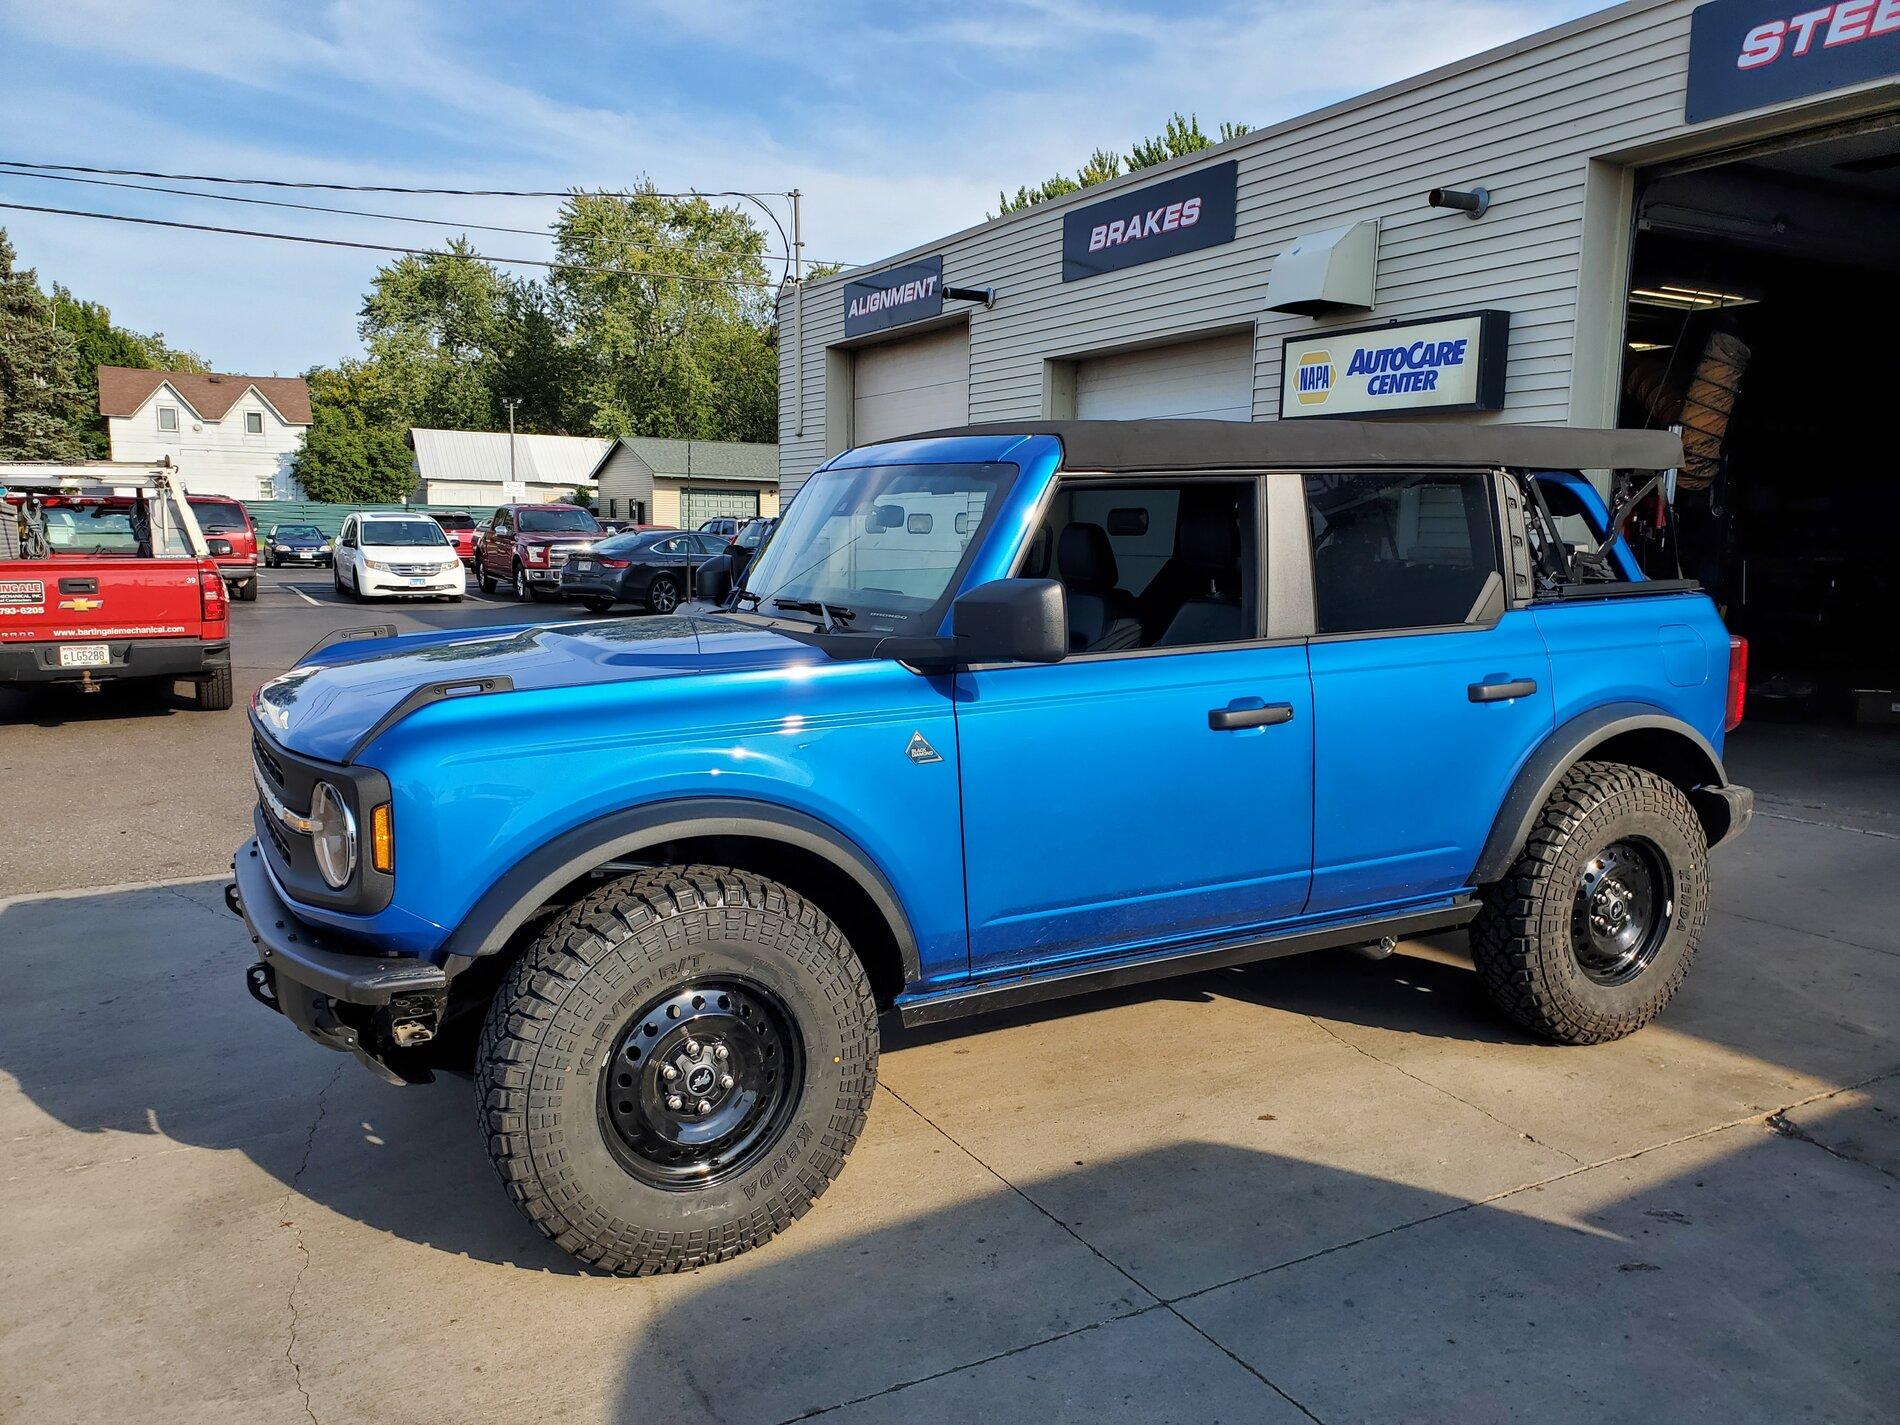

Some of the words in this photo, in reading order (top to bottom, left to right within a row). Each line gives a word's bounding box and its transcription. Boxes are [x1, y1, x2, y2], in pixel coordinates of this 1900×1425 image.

[1088, 197, 1202, 253] BRAKES
[847, 275, 938, 319] ALIGNMENT
[1300, 365, 1329, 391] NAPA
[1367, 370, 1438, 395] CENTER
[53, 626, 185, 637] www.bartingalemechanical.com
[576, 977, 654, 1076] KLEVER
[742, 1120, 815, 1201] KENDA
